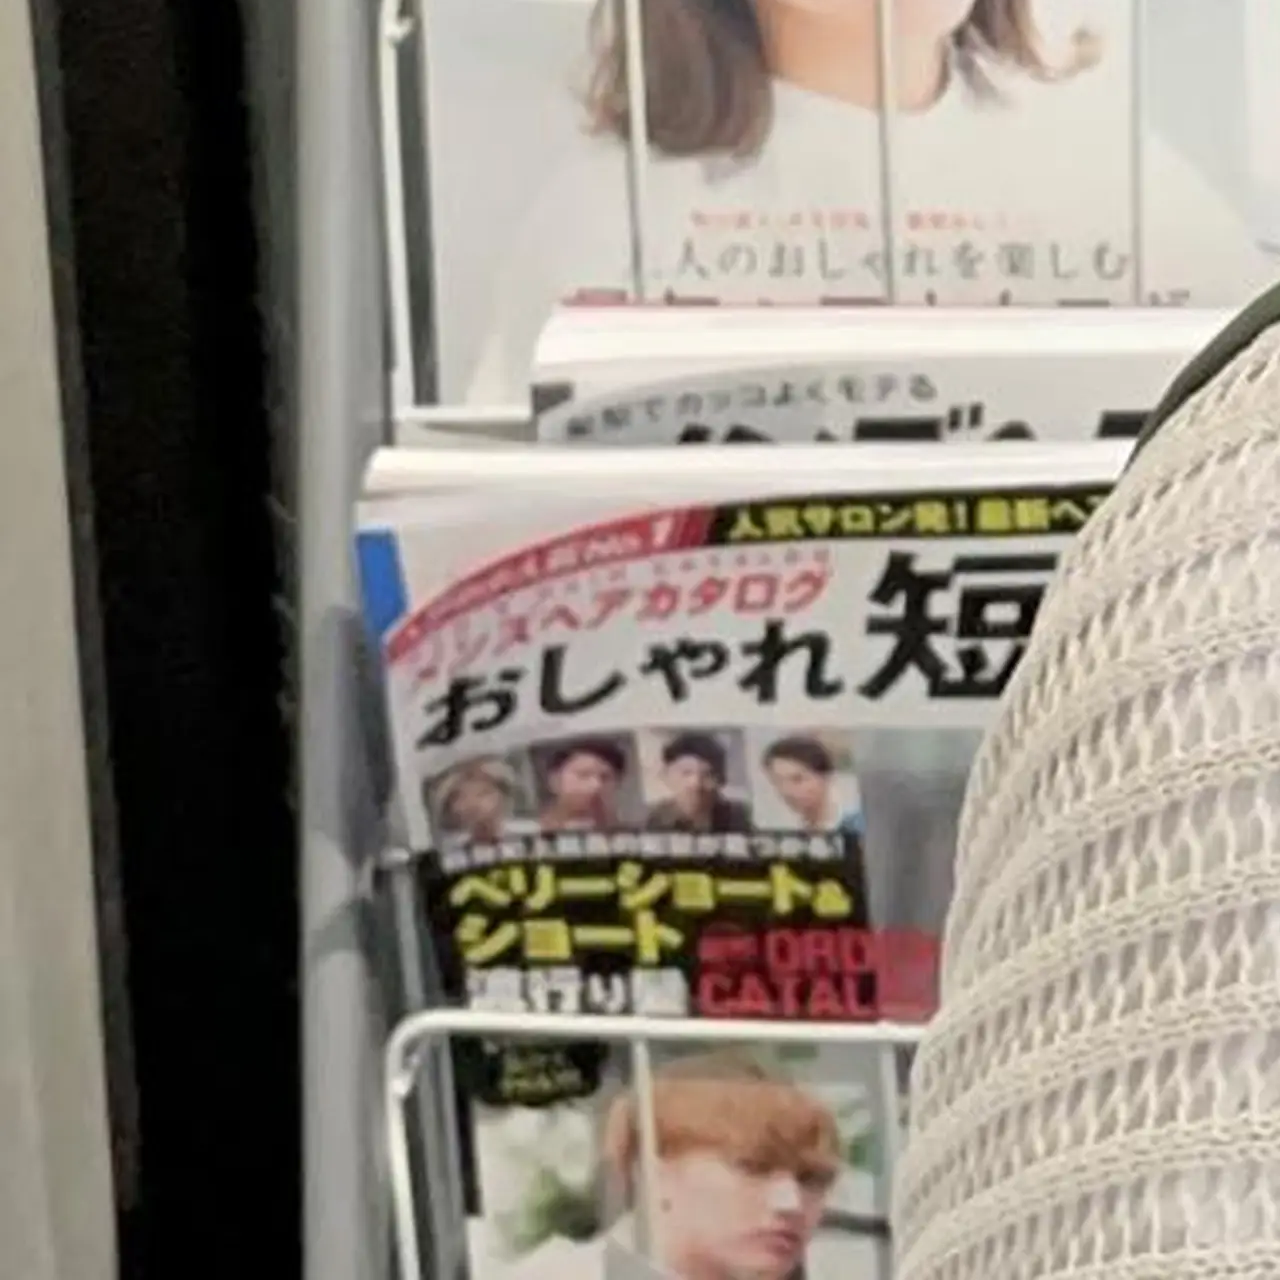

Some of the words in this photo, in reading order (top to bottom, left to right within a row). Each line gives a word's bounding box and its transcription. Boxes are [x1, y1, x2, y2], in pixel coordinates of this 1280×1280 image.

[640, 235, 1131, 282] 人のおしゃれを楽しむ
[454, 908, 685, 965] ショート
